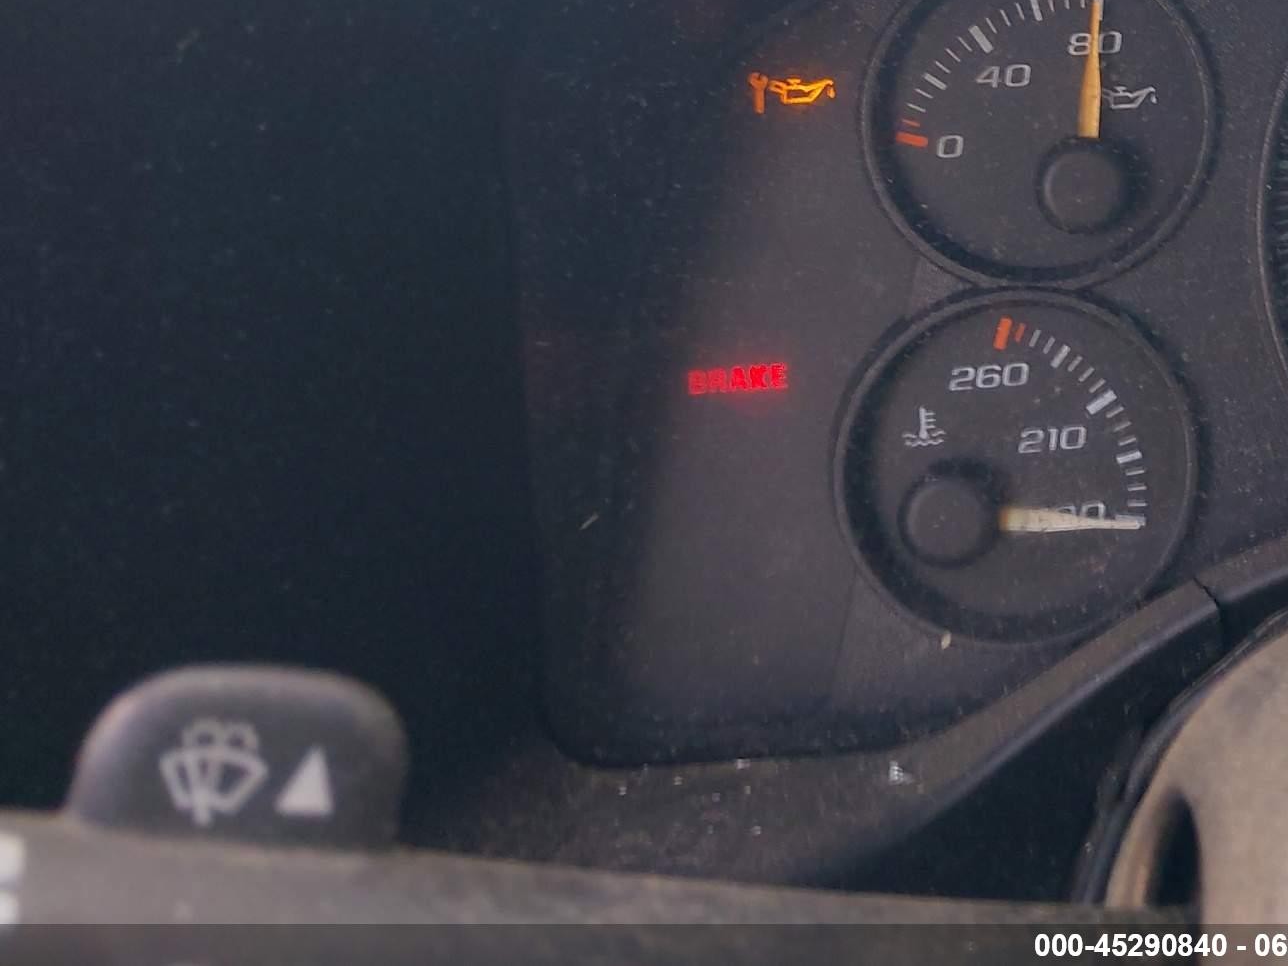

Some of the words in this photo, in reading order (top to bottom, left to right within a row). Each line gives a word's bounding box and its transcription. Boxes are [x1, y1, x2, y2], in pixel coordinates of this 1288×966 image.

[1068, 31, 1122, 56] 80
[977, 64, 1031, 88] 40
[937, 135, 964, 158] 0
[688, 363, 788, 394] BRAKE
[949, 363, 1029, 391] 260
[1018, 426, 1087, 453] 210
